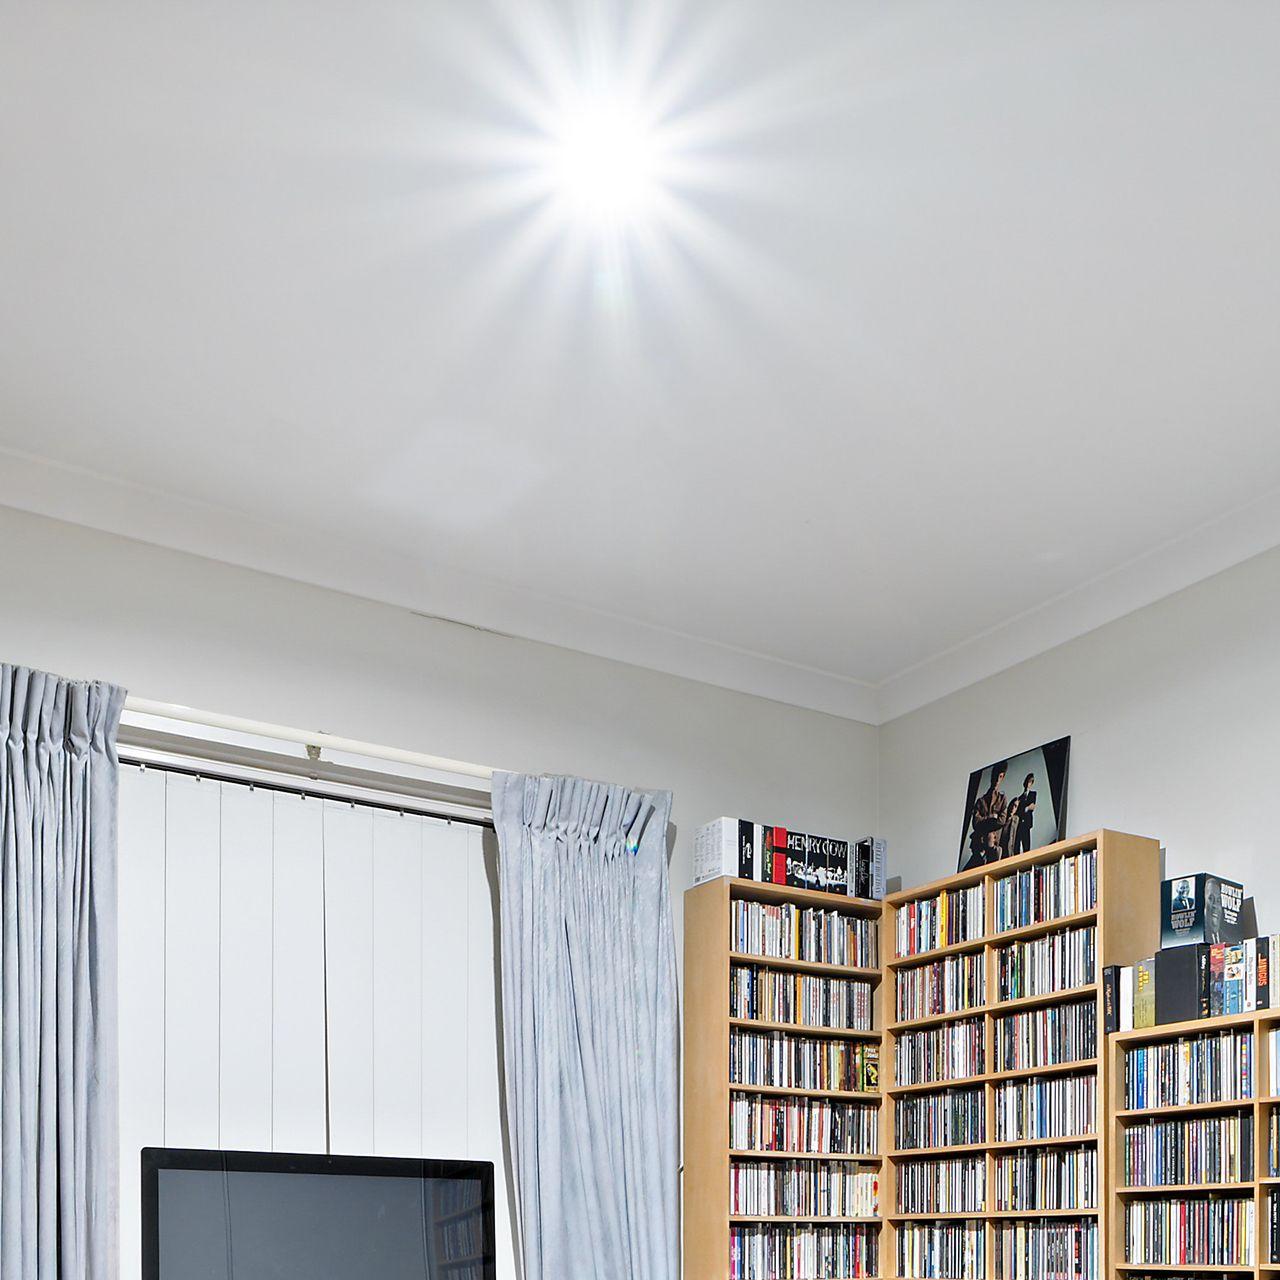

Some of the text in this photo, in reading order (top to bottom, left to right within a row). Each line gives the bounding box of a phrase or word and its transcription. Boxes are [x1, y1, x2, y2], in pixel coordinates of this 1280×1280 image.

[787, 834, 848, 858] HENRY COW
[1221, 893, 1243, 911] WOLF
[1258, 957, 1268, 986] MINGUS
